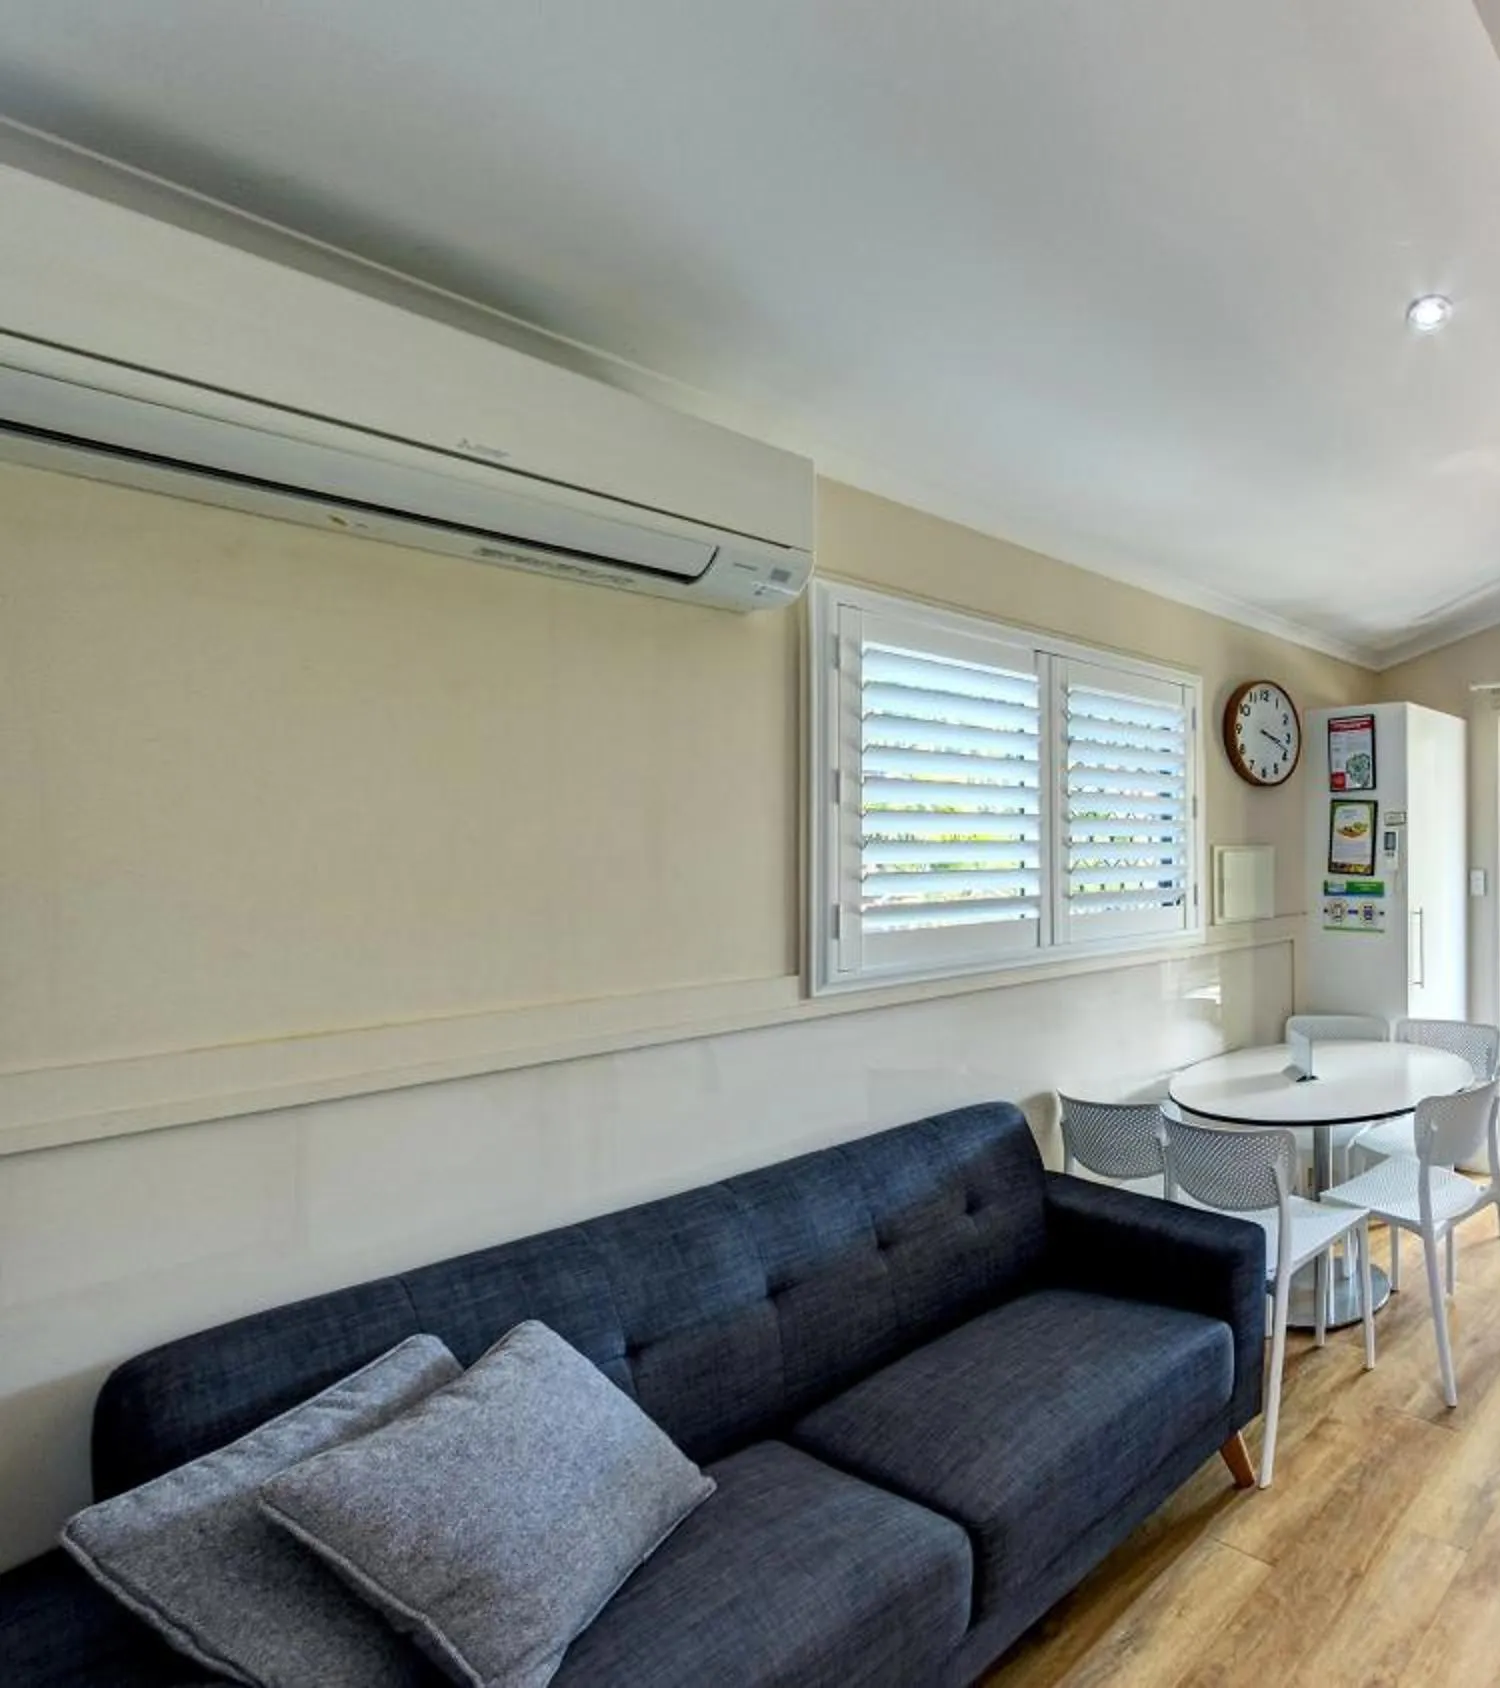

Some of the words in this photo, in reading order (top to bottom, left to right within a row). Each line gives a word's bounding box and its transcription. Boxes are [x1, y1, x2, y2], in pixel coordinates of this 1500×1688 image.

[1249, 691, 1257, 704] 11
[1260, 690, 1269, 702] 12
[1240, 703, 1251, 717] 10
[1236, 723, 1243, 735] 9
